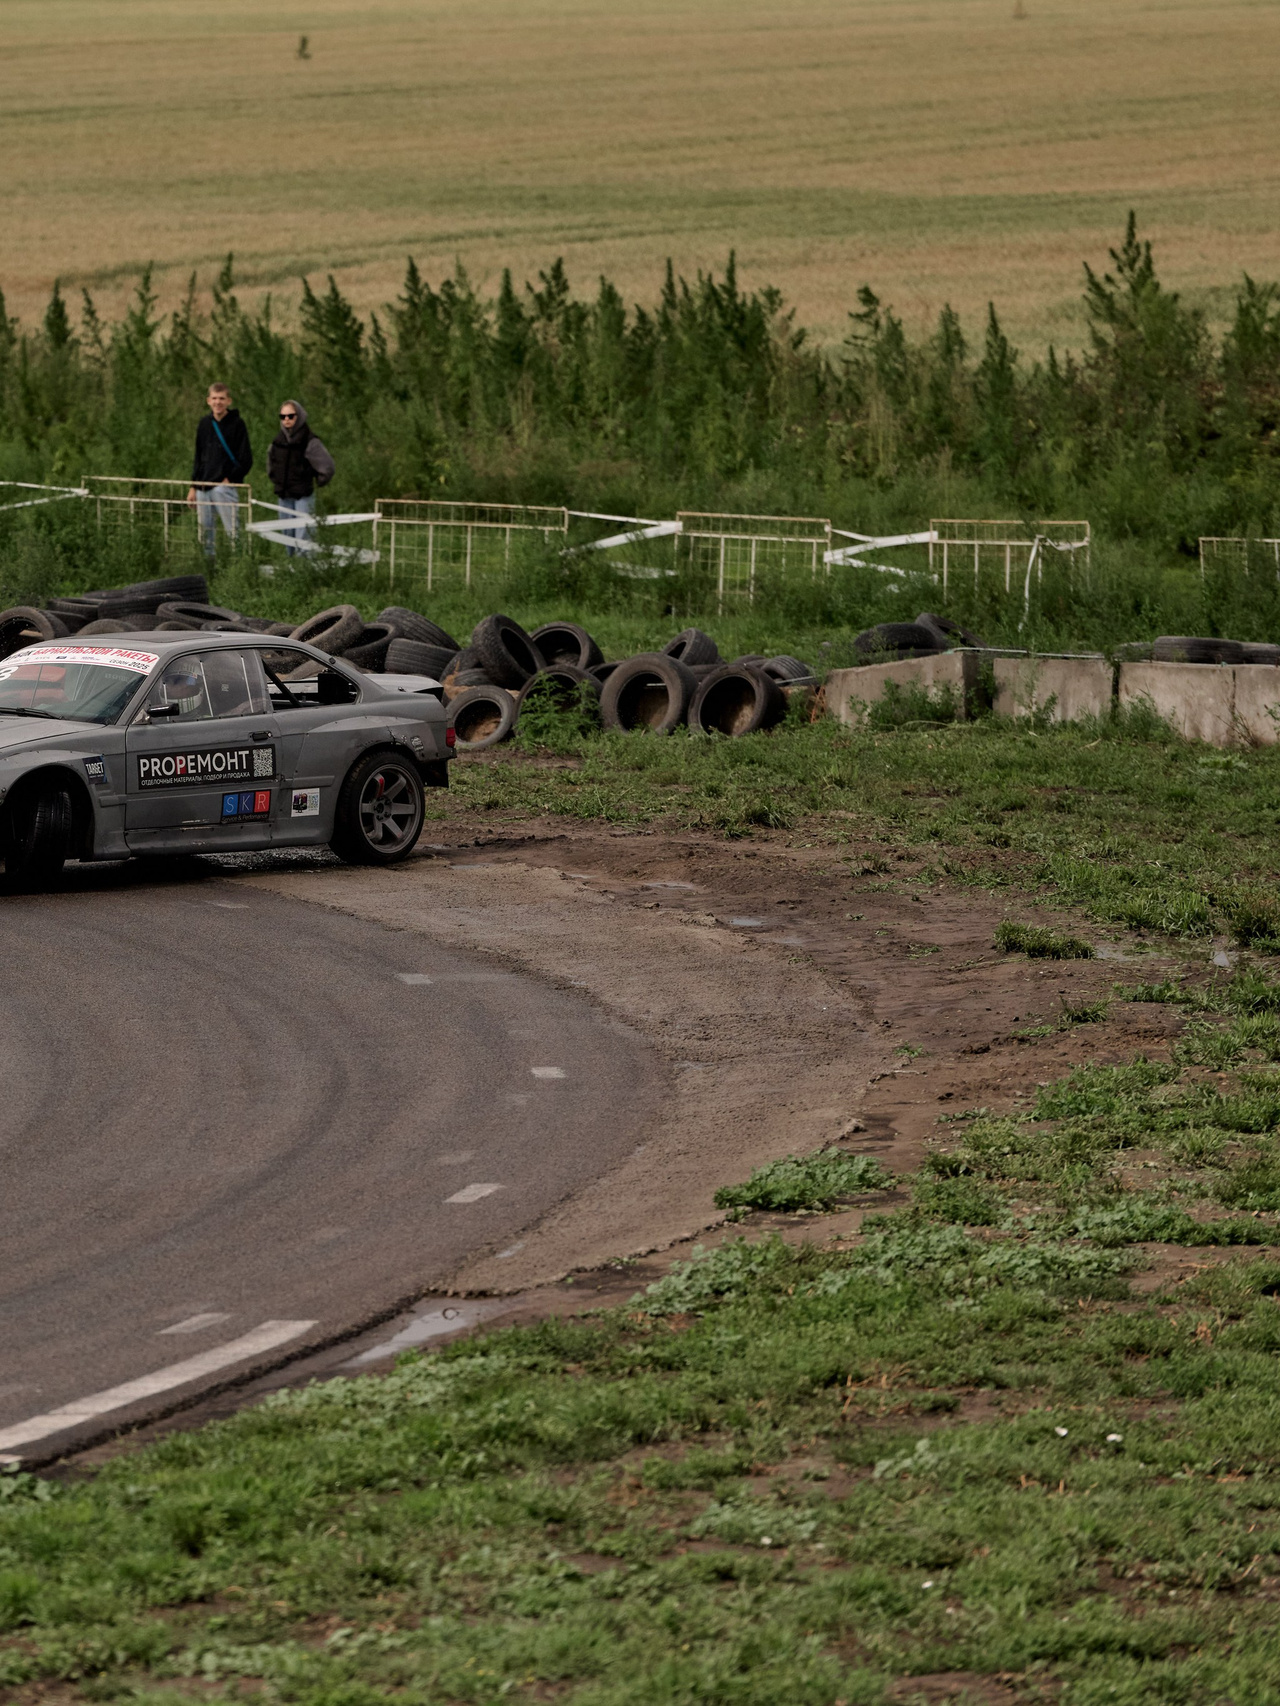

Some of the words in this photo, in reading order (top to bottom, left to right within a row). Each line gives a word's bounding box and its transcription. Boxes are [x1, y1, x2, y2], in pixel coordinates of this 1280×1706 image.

[110, 649, 158, 663] РАКЕТЫ
[128, 661, 150, 670] 2025
[85, 762, 104, 775] TARGET
[141, 777, 173, 786] ОТДЕЛОЧНЫЕ
[203, 773, 223, 781] ПОДБОР
[228, 771, 251, 779] ПРОДАЖА
